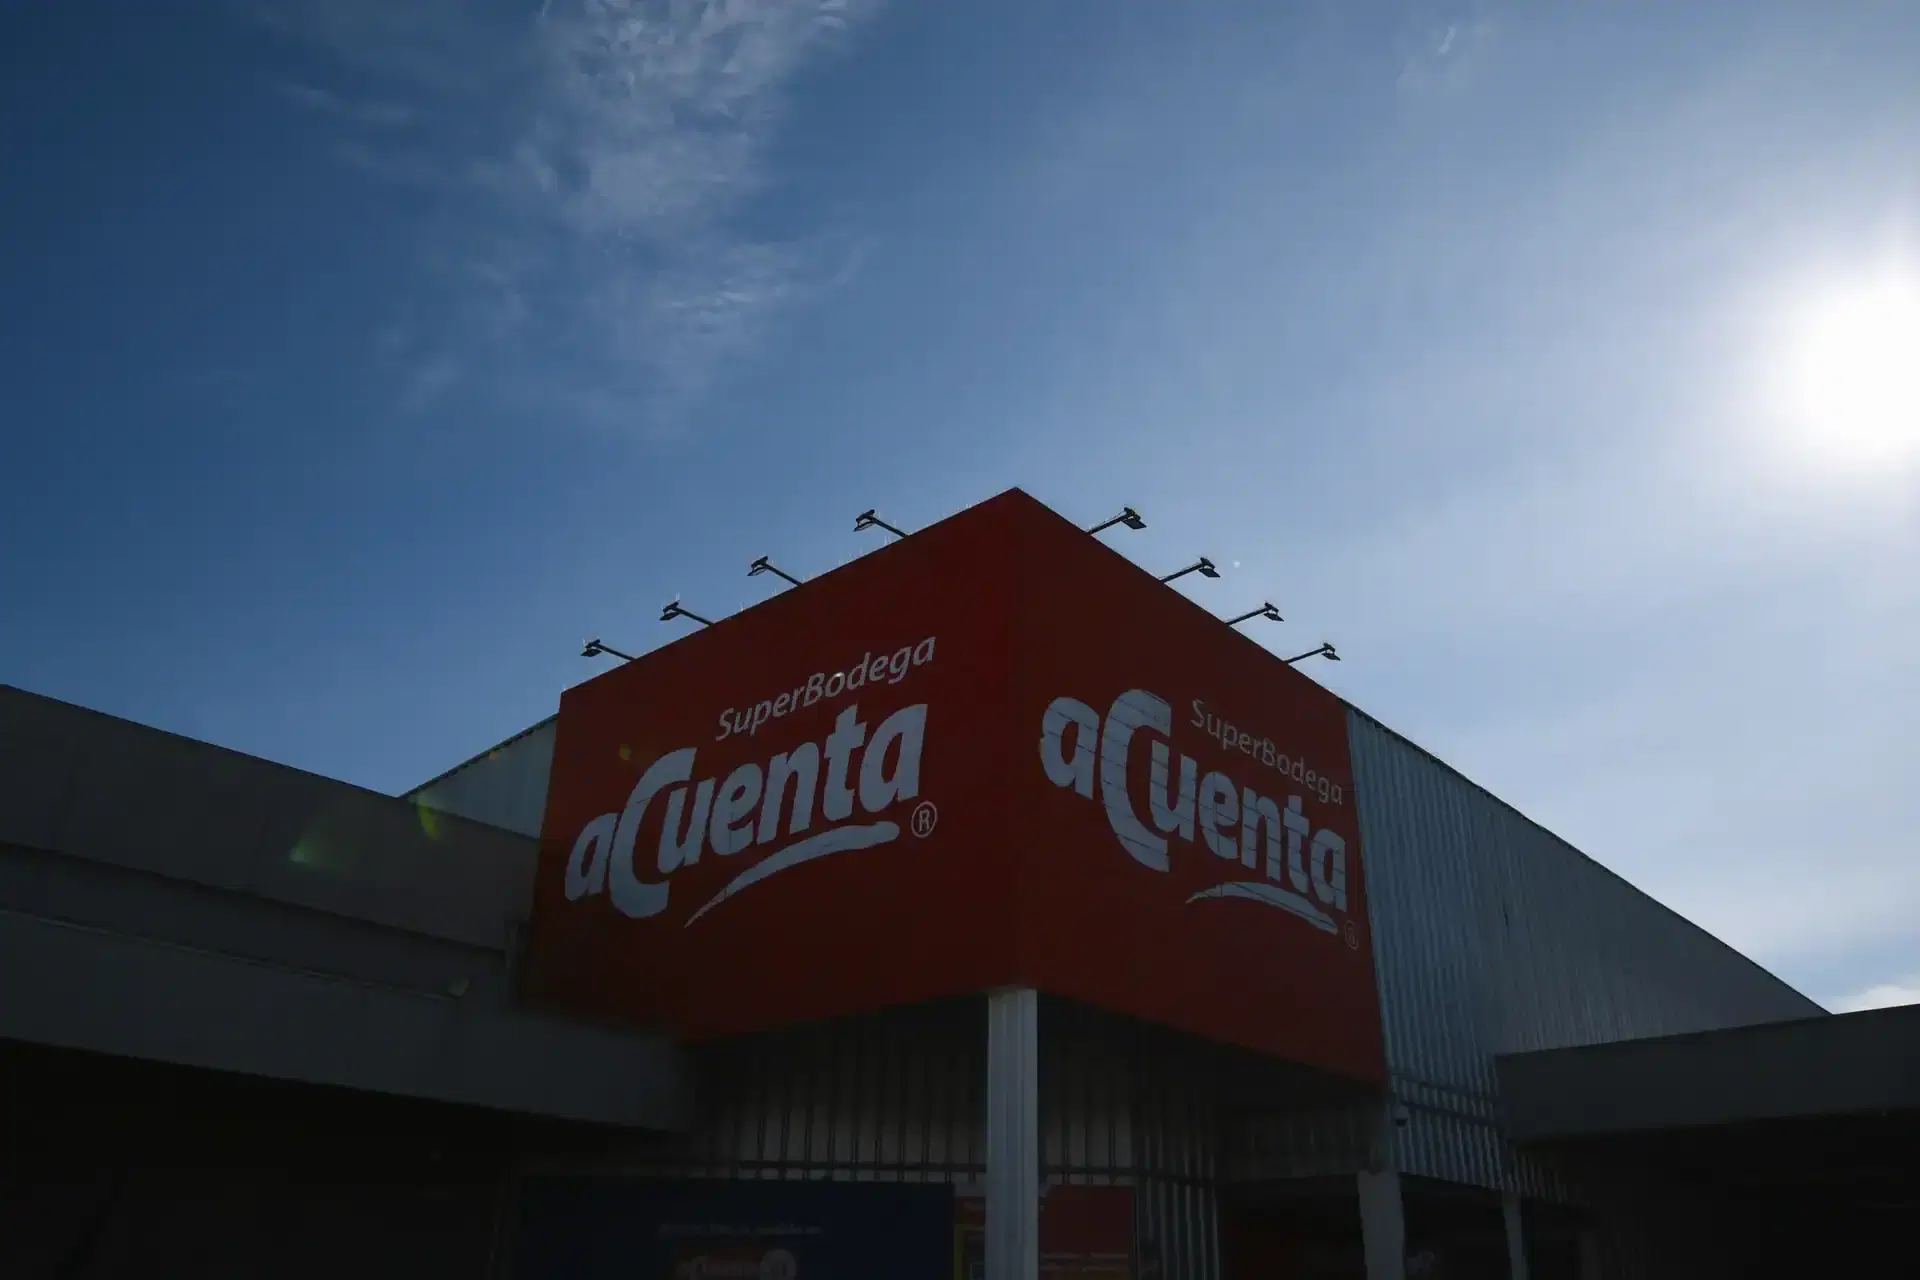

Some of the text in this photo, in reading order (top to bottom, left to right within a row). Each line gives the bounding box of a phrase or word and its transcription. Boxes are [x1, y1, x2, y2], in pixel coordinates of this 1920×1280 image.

[715, 636, 936, 741] SuperBodega
[1190, 698, 1343, 806] SuperBodega
[564, 703, 929, 919] aCuenta
[1040, 688, 1347, 913] aCuenta
